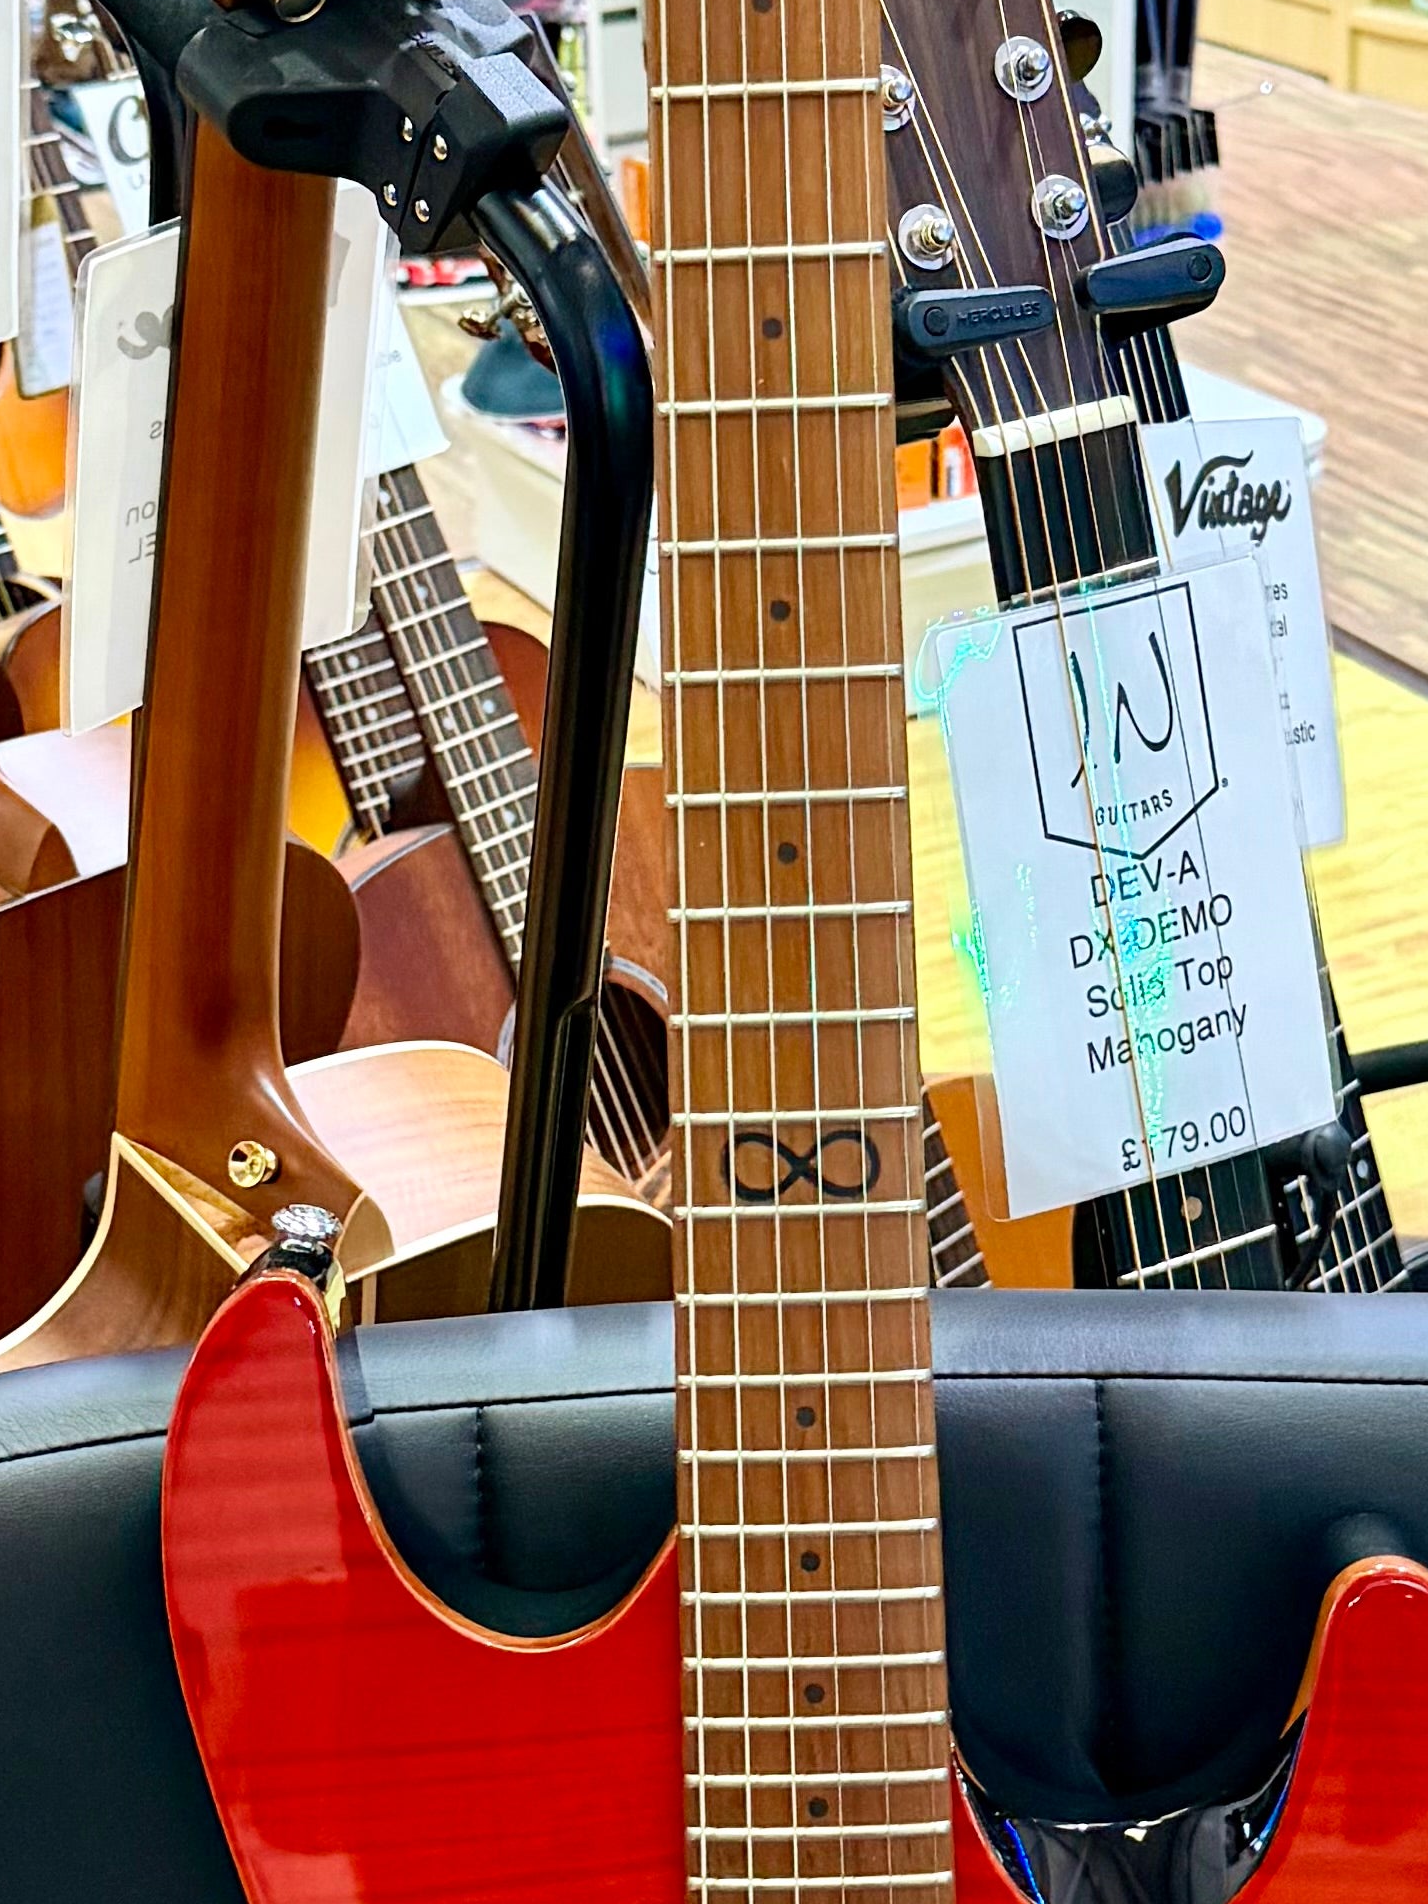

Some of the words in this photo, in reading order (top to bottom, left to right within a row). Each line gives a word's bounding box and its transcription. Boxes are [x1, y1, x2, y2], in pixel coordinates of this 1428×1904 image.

[1164, 449, 1293, 547] Vintage
[1095, 788, 1174, 827] GUITARS
[1090, 850, 1201, 909] DEV-A
[1087, 966, 1167, 1018] Solid
[1175, 955, 1234, 992] Top
[1087, 1004, 1247, 1073] Mahogany
